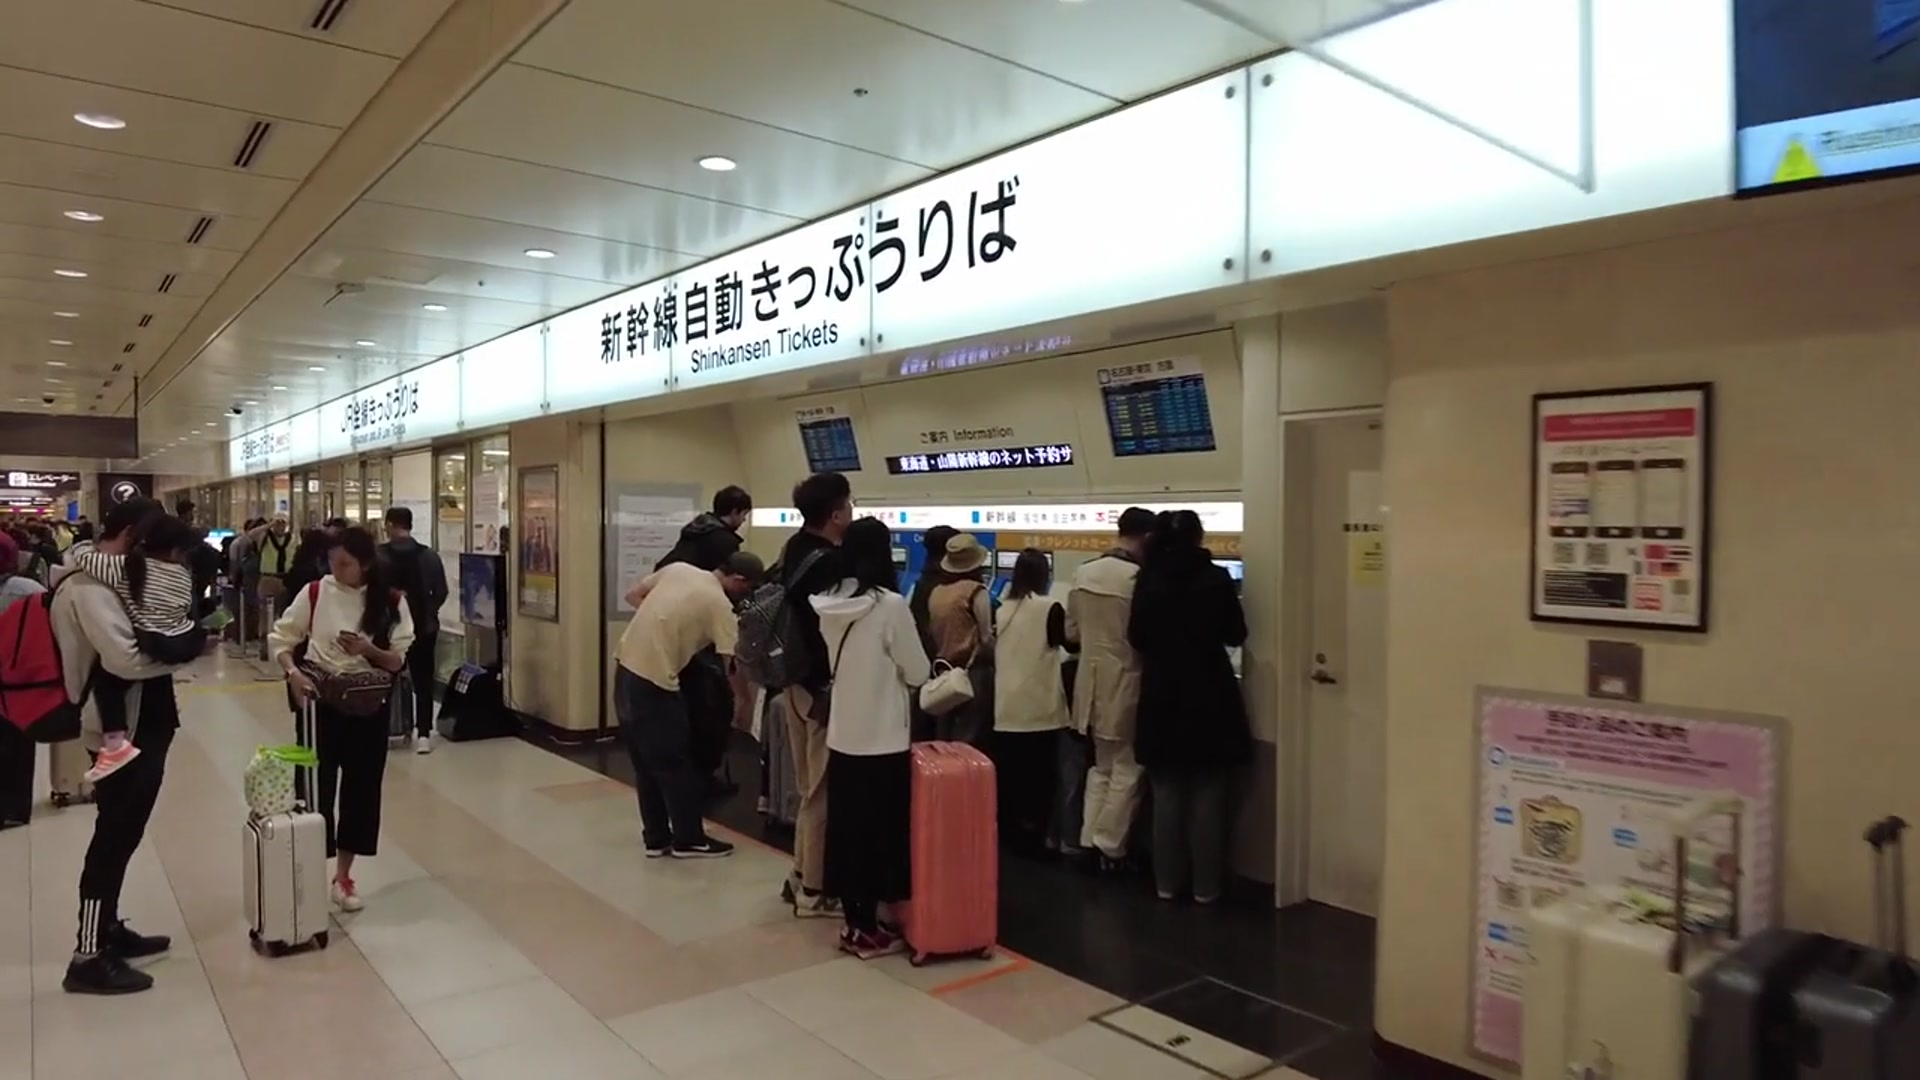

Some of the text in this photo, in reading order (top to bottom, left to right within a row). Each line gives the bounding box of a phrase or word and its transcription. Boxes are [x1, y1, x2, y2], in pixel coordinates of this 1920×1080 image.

[600, 174, 1020, 365] 新幹線自動きっぷうりば
[690, 320, 839, 374] Shinkansen Tickets
[952, 425, 1014, 442] Information
